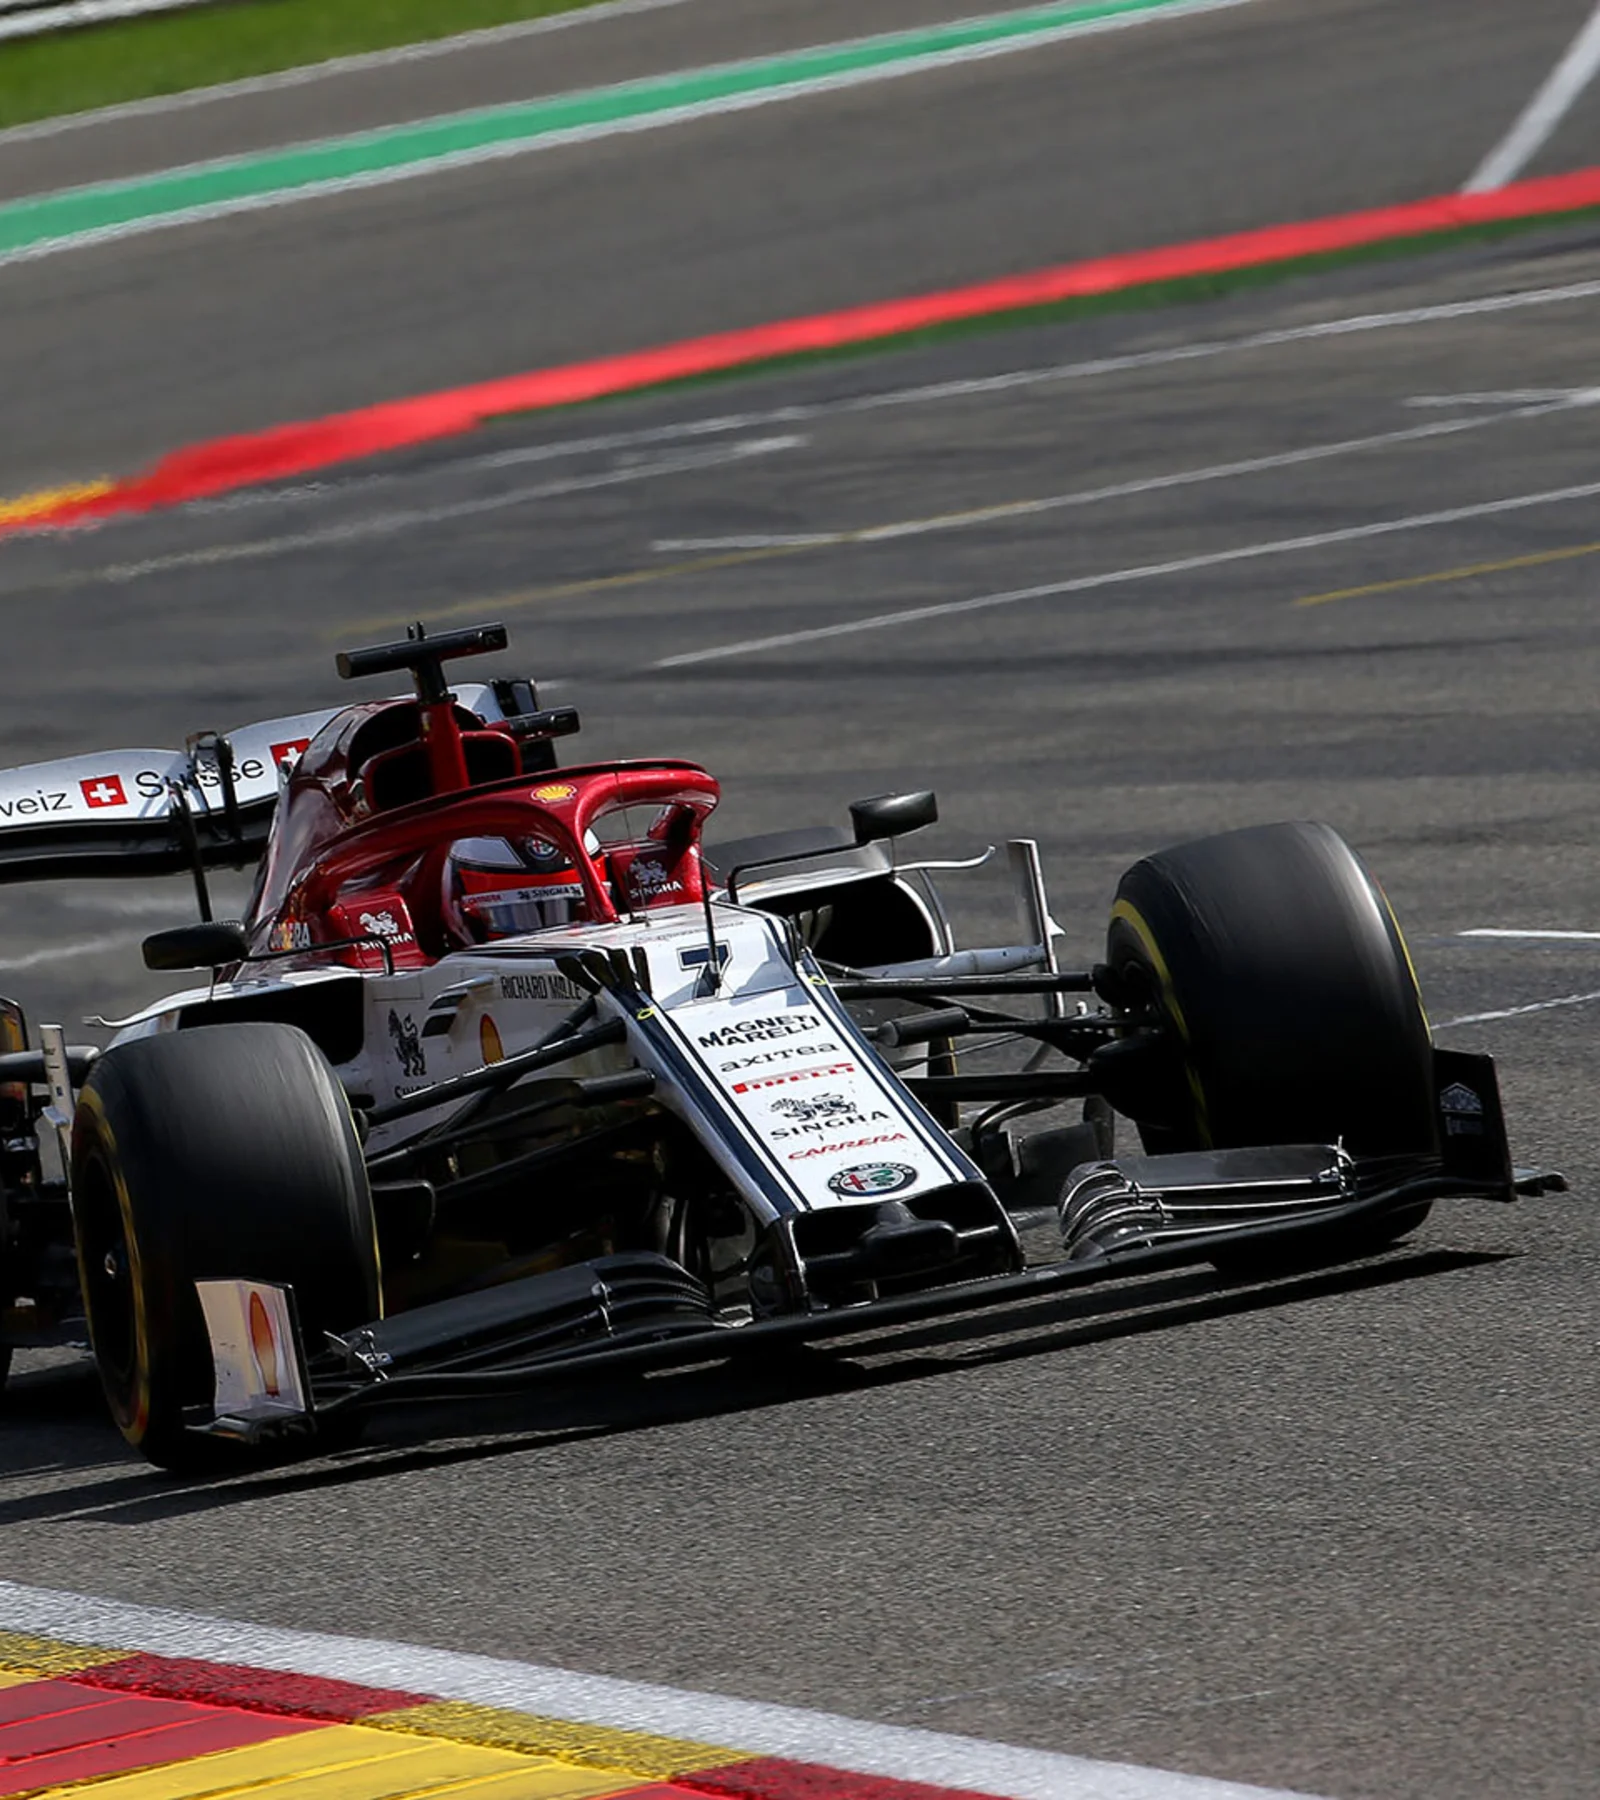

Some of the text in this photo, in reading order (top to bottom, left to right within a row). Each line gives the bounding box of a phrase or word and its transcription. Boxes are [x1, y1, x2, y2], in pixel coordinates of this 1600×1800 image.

[531, 885, 569, 900] SINGHA
[630, 880, 683, 899] SINGHA
[676, 939, 733, 1004] 7
[500, 975, 548, 1000] RICHARD
[698, 1015, 820, 1046] MAGNETI
[698, 1017, 820, 1048] MARELLI
[771, 1110, 889, 1140] SINGHA
[788, 1132, 908, 1160] CARRERA
